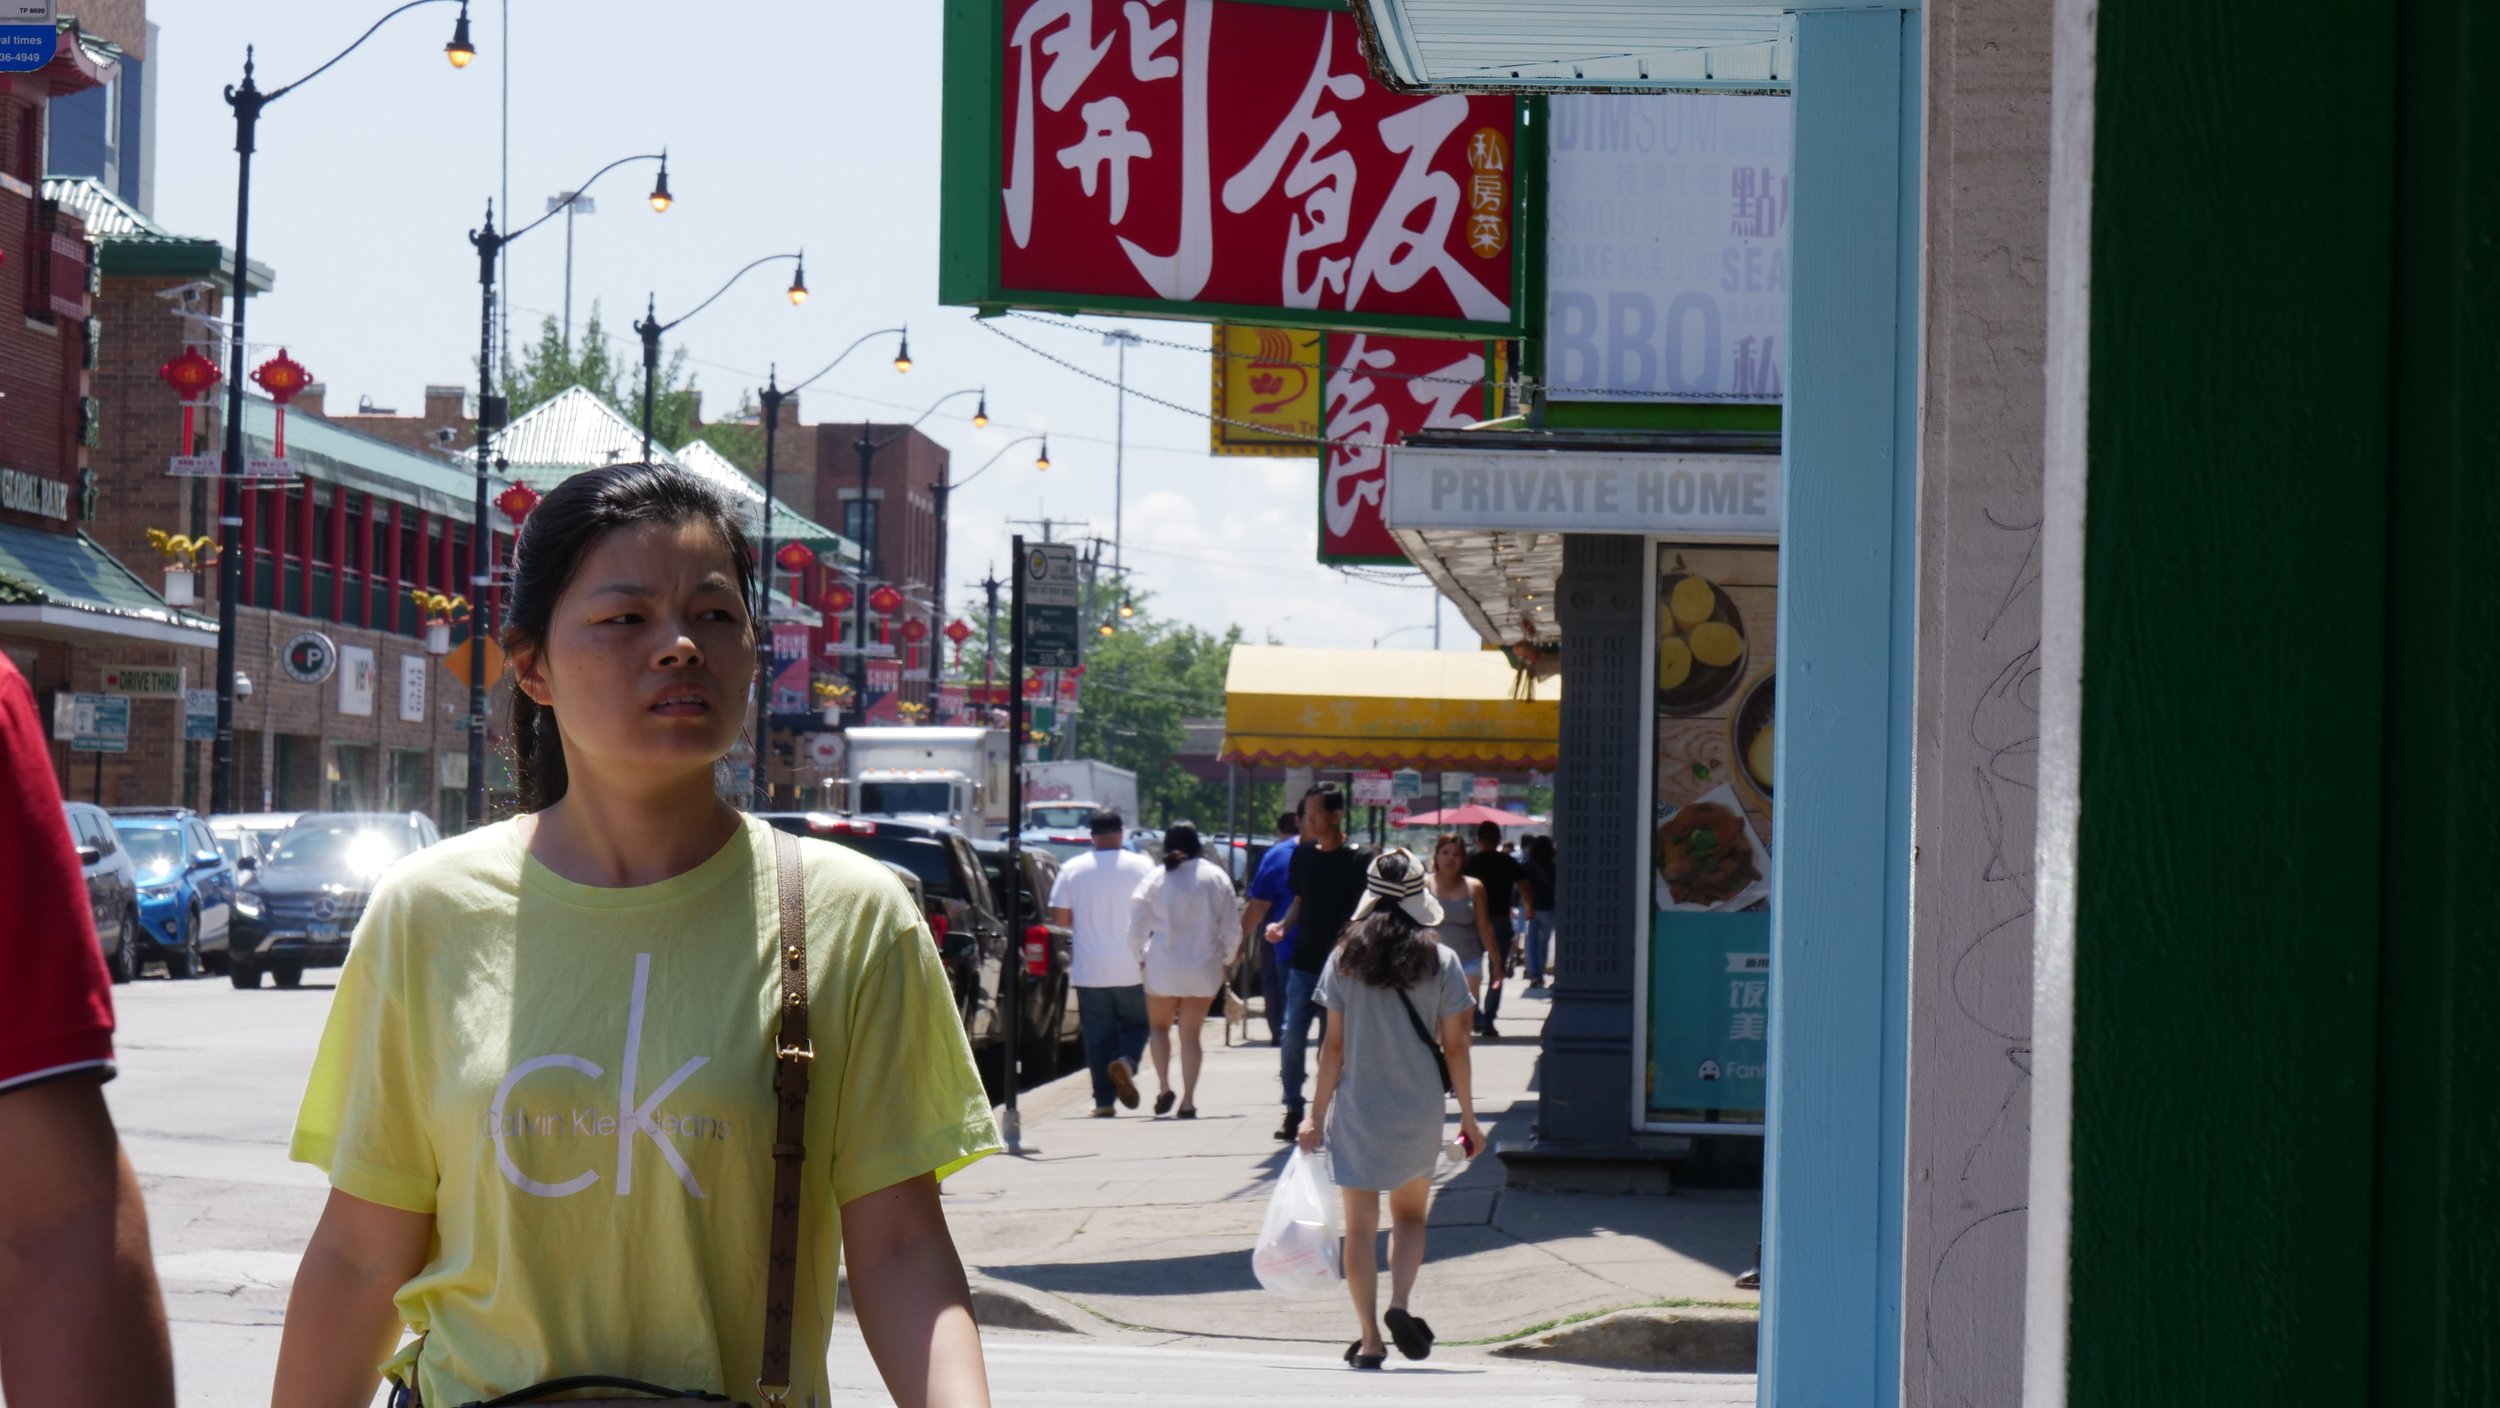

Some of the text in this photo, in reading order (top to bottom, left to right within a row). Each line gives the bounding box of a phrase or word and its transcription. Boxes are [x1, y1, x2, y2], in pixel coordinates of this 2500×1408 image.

[13, 36, 42, 45] times
[1468, 131, 1506, 251] 私房菜
[1550, 290, 1722, 401] BBQ
[1431, 467, 1767, 516] PRIVATE HOME
[307, 649, 321, 668] P
[119, 671, 179, 692] DRIVE THRU
[491, 953, 711, 1199] ck
[481, 1106, 564, 1138] Calvin
[571, 1108, 640, 1137] Klein
